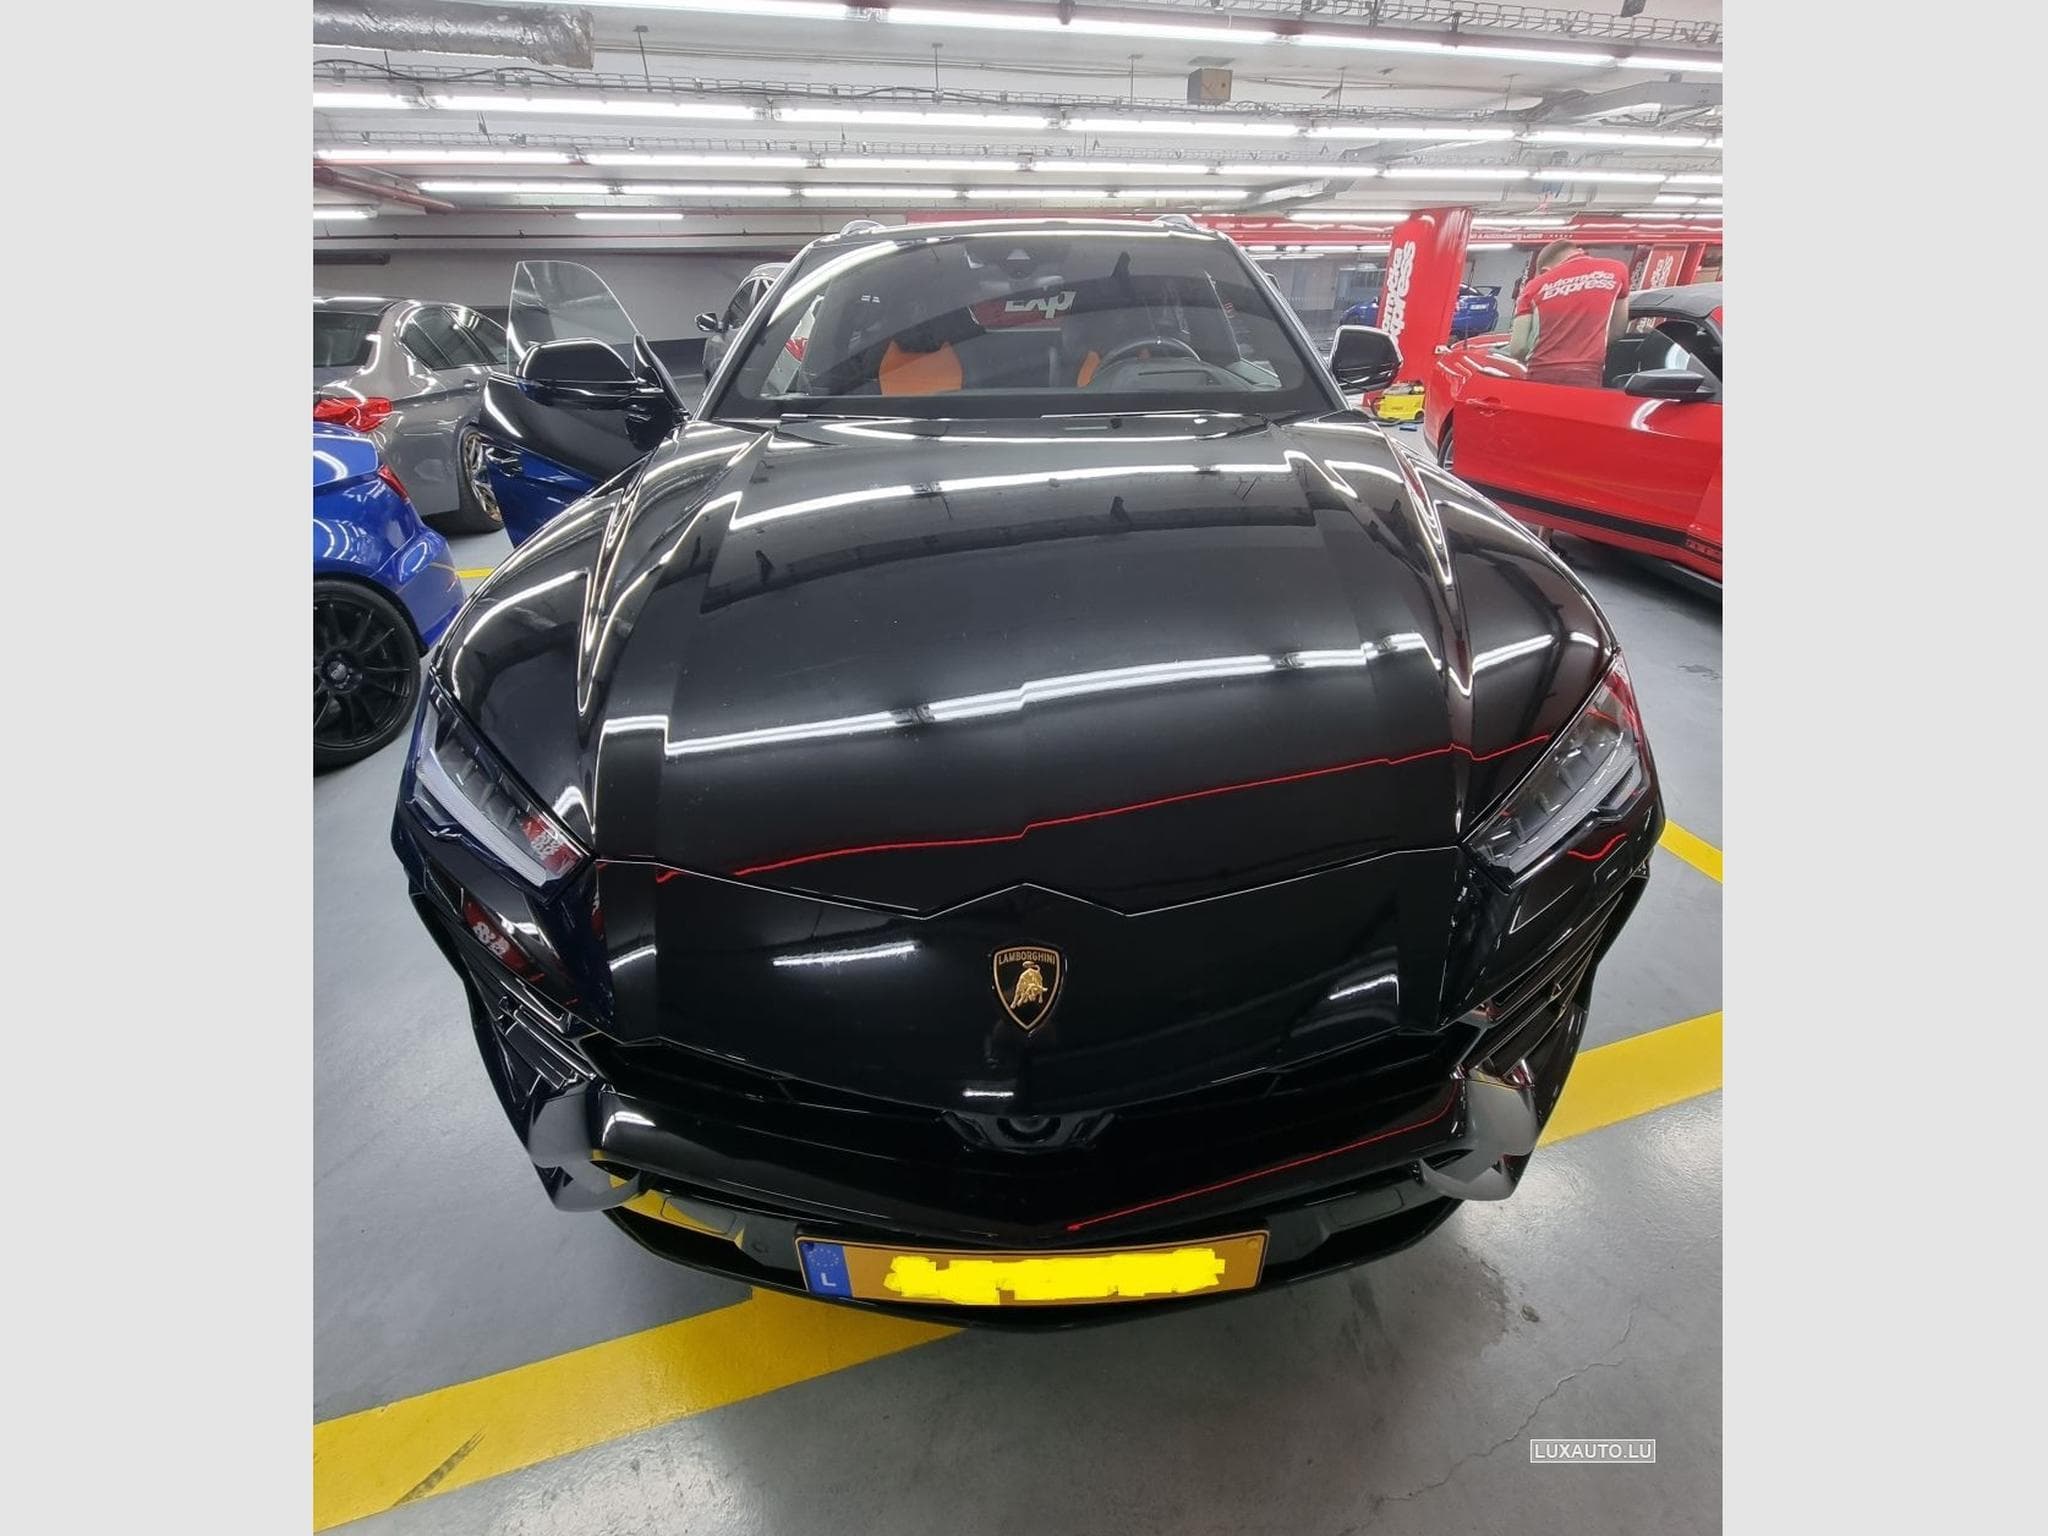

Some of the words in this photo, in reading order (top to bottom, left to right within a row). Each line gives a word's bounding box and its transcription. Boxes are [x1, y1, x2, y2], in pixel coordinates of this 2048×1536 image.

[1541, 279, 1617, 301] Express
[998, 951, 1056, 965] LAMBORGHINI
[821, 1272, 838, 1288] L
